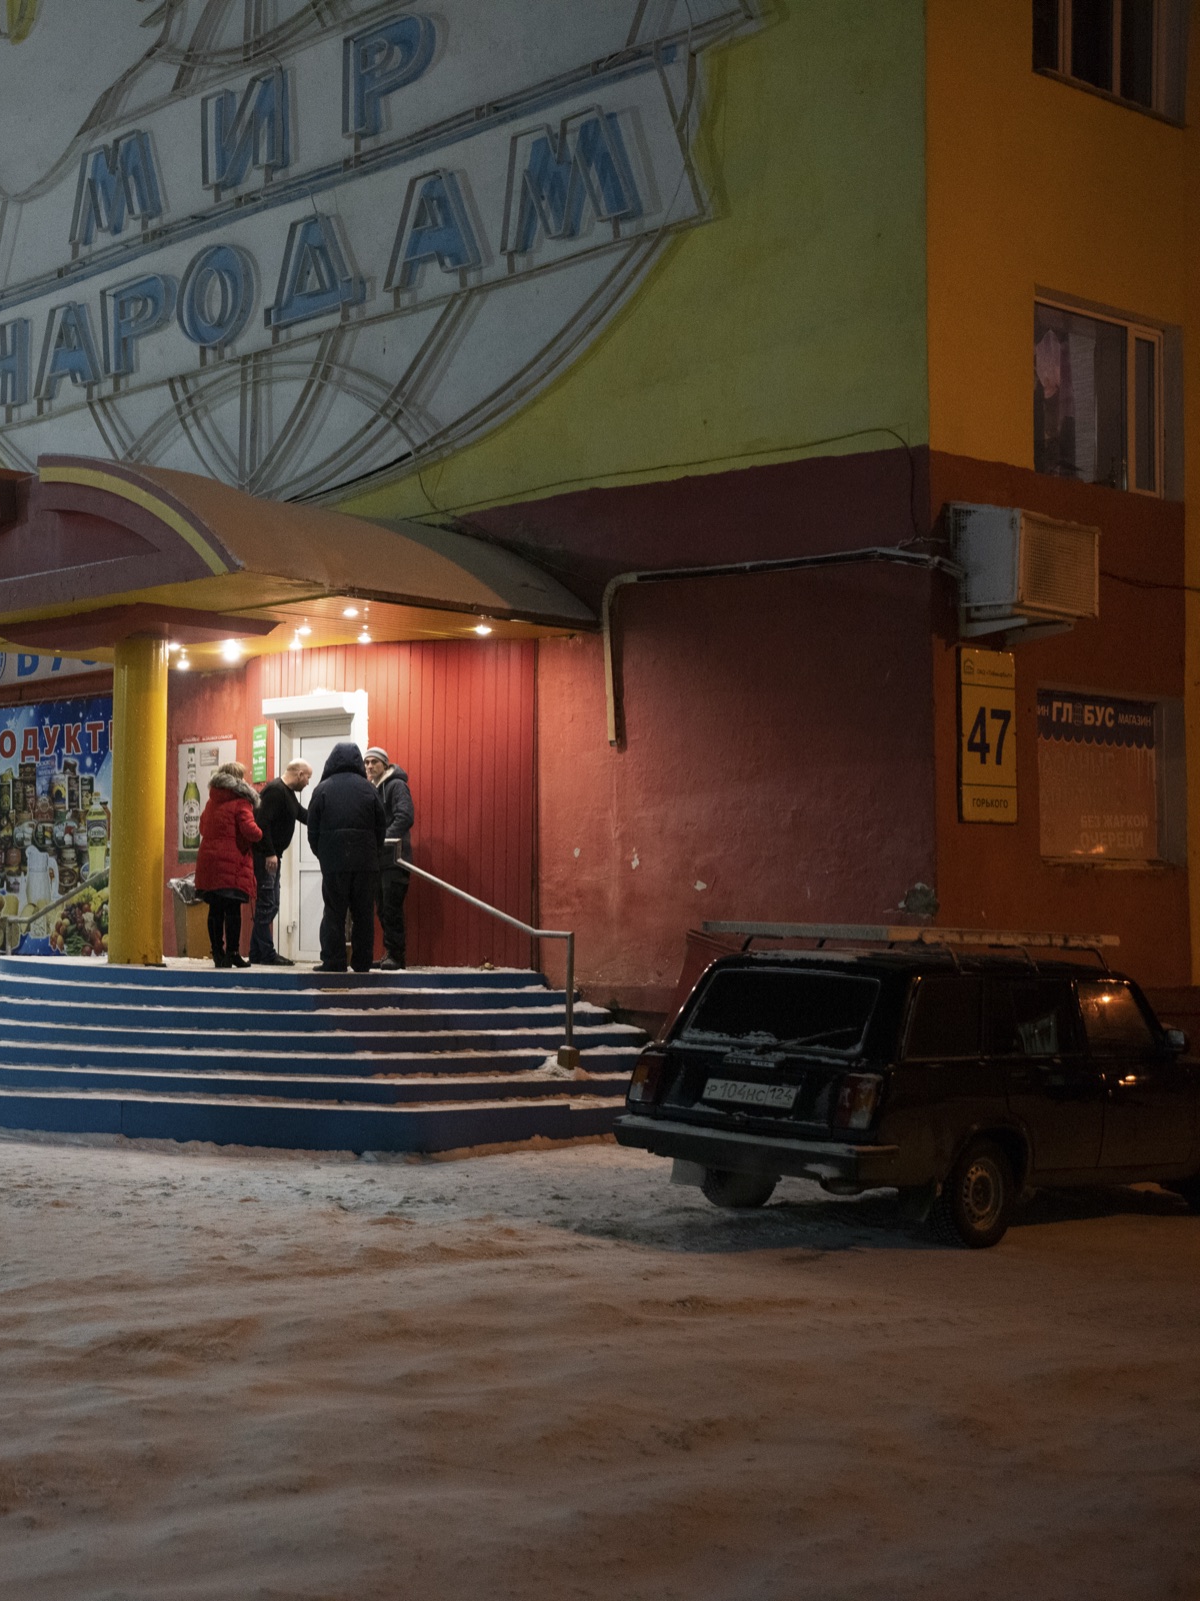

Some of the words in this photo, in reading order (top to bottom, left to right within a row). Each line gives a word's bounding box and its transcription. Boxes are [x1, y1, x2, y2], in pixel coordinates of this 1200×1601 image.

[68, 14, 437, 246] МИР
[1117, 712, 1152, 727] МАГАЗИН
[967, 706, 1012, 765] 47
[972, 797, 1009, 809] ГОРЬКОГО
[1080, 814, 1101, 828] БЕЗ
[1103, 812, 1148, 828] ЖАРКОЙ
